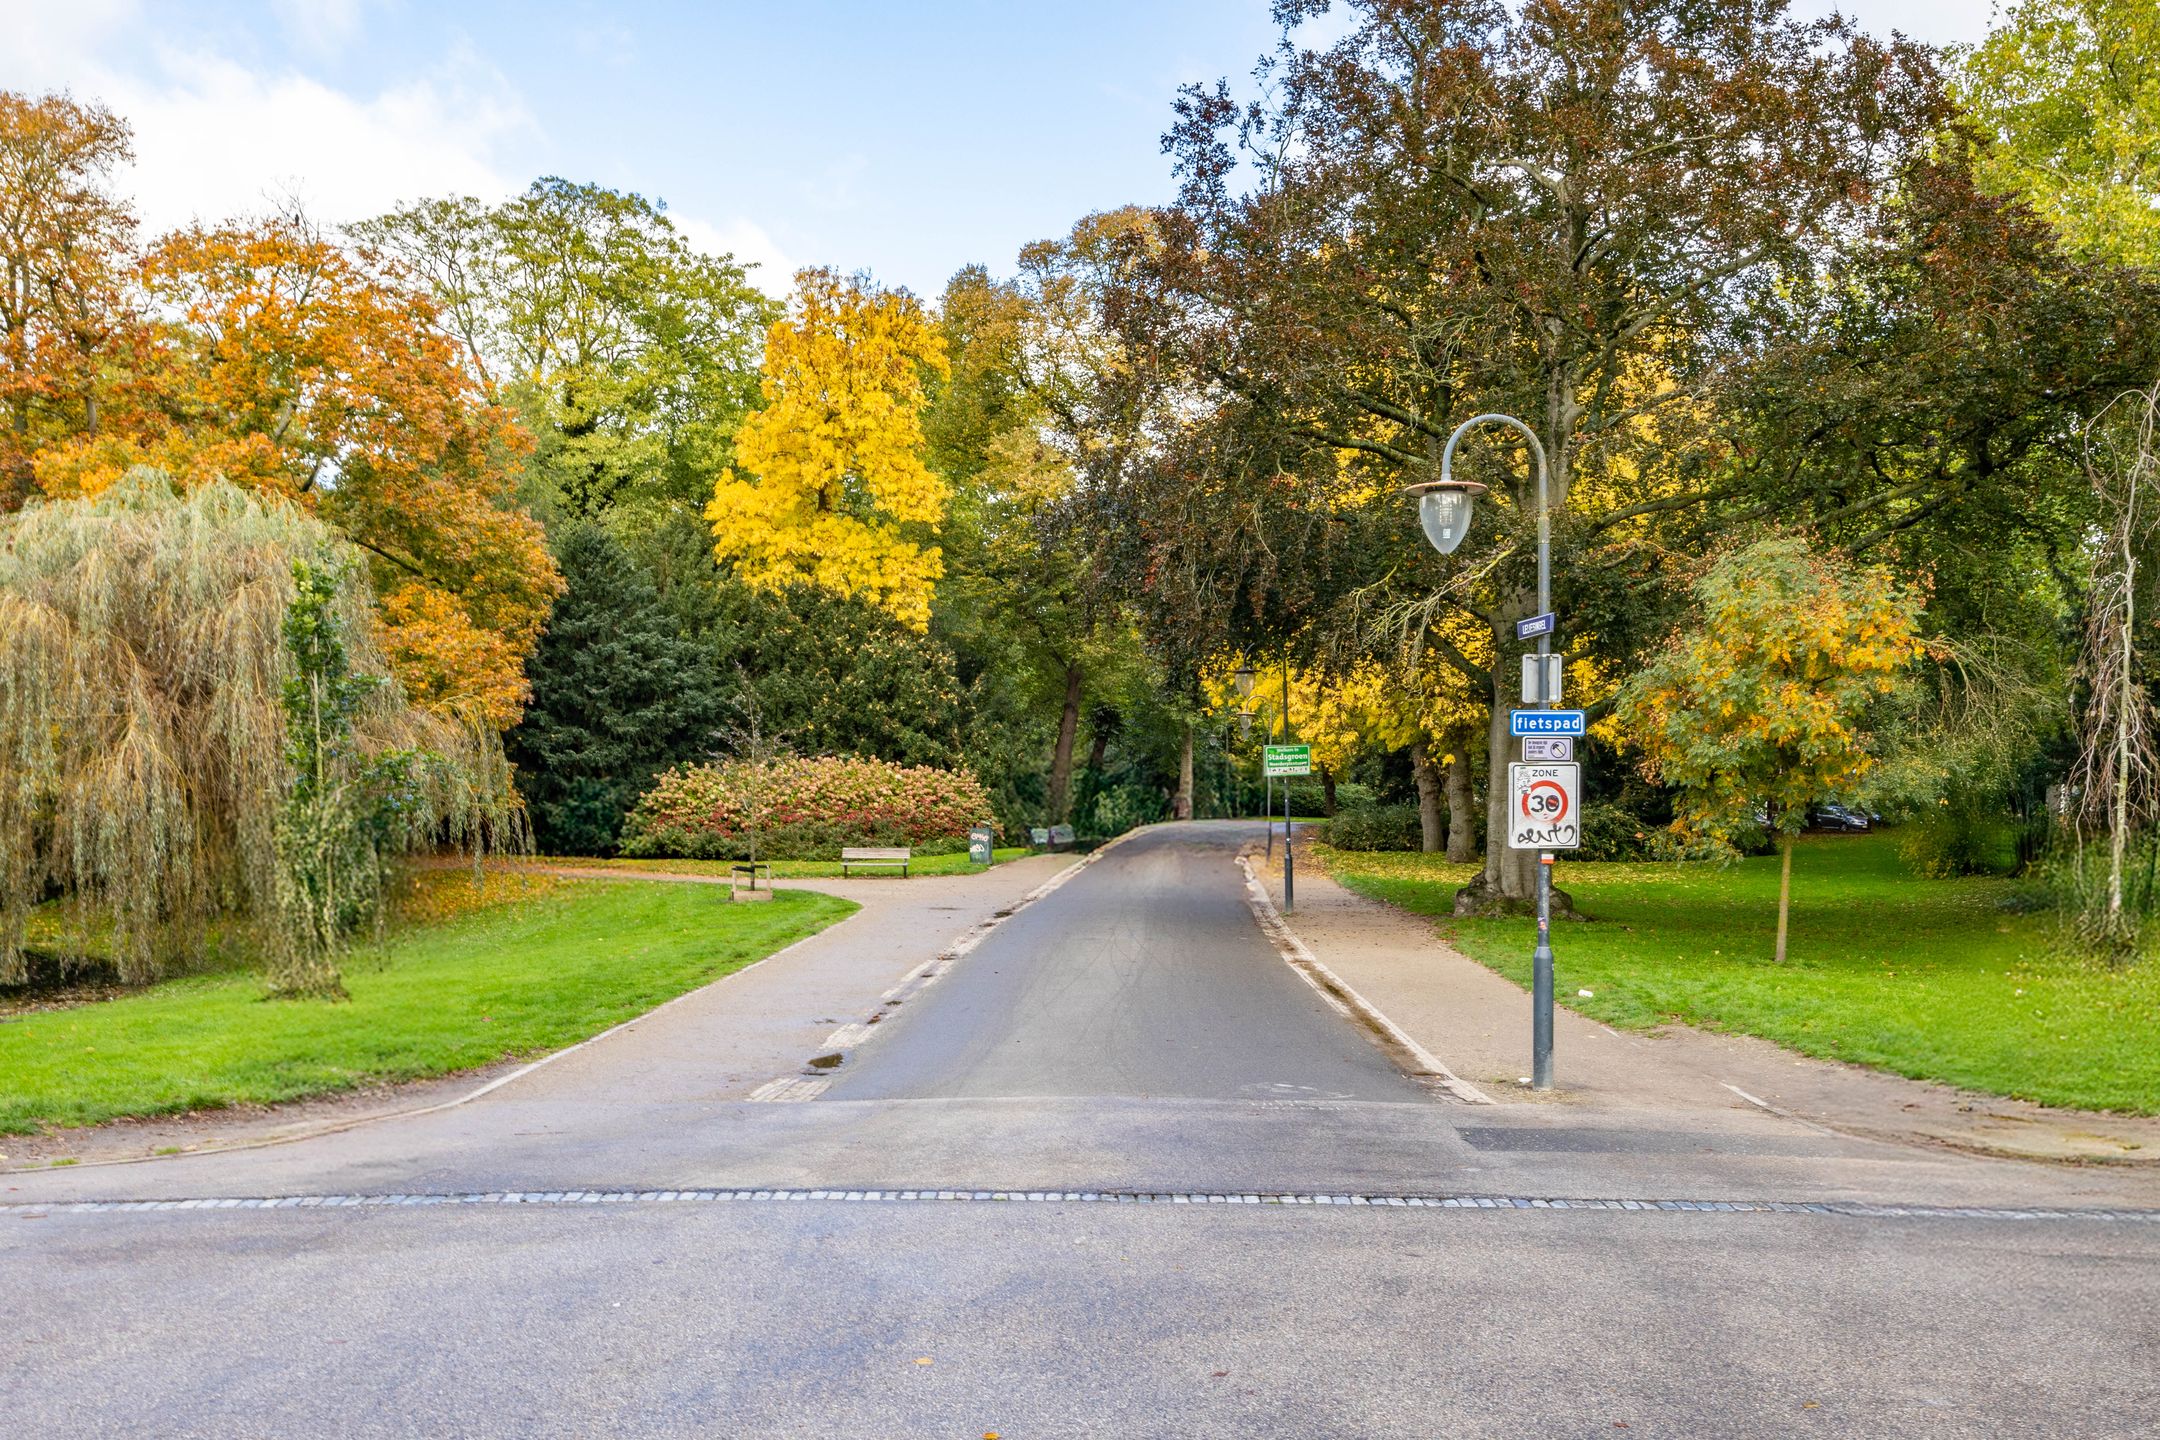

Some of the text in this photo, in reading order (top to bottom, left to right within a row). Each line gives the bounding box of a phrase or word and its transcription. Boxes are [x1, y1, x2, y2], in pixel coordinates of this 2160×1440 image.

[1517, 717, 1580, 731] fietspad
[1268, 753, 1308, 761] Stadsgroen
[1532, 769, 1559, 777] ZONE
[1531, 794, 1560, 812] 30
